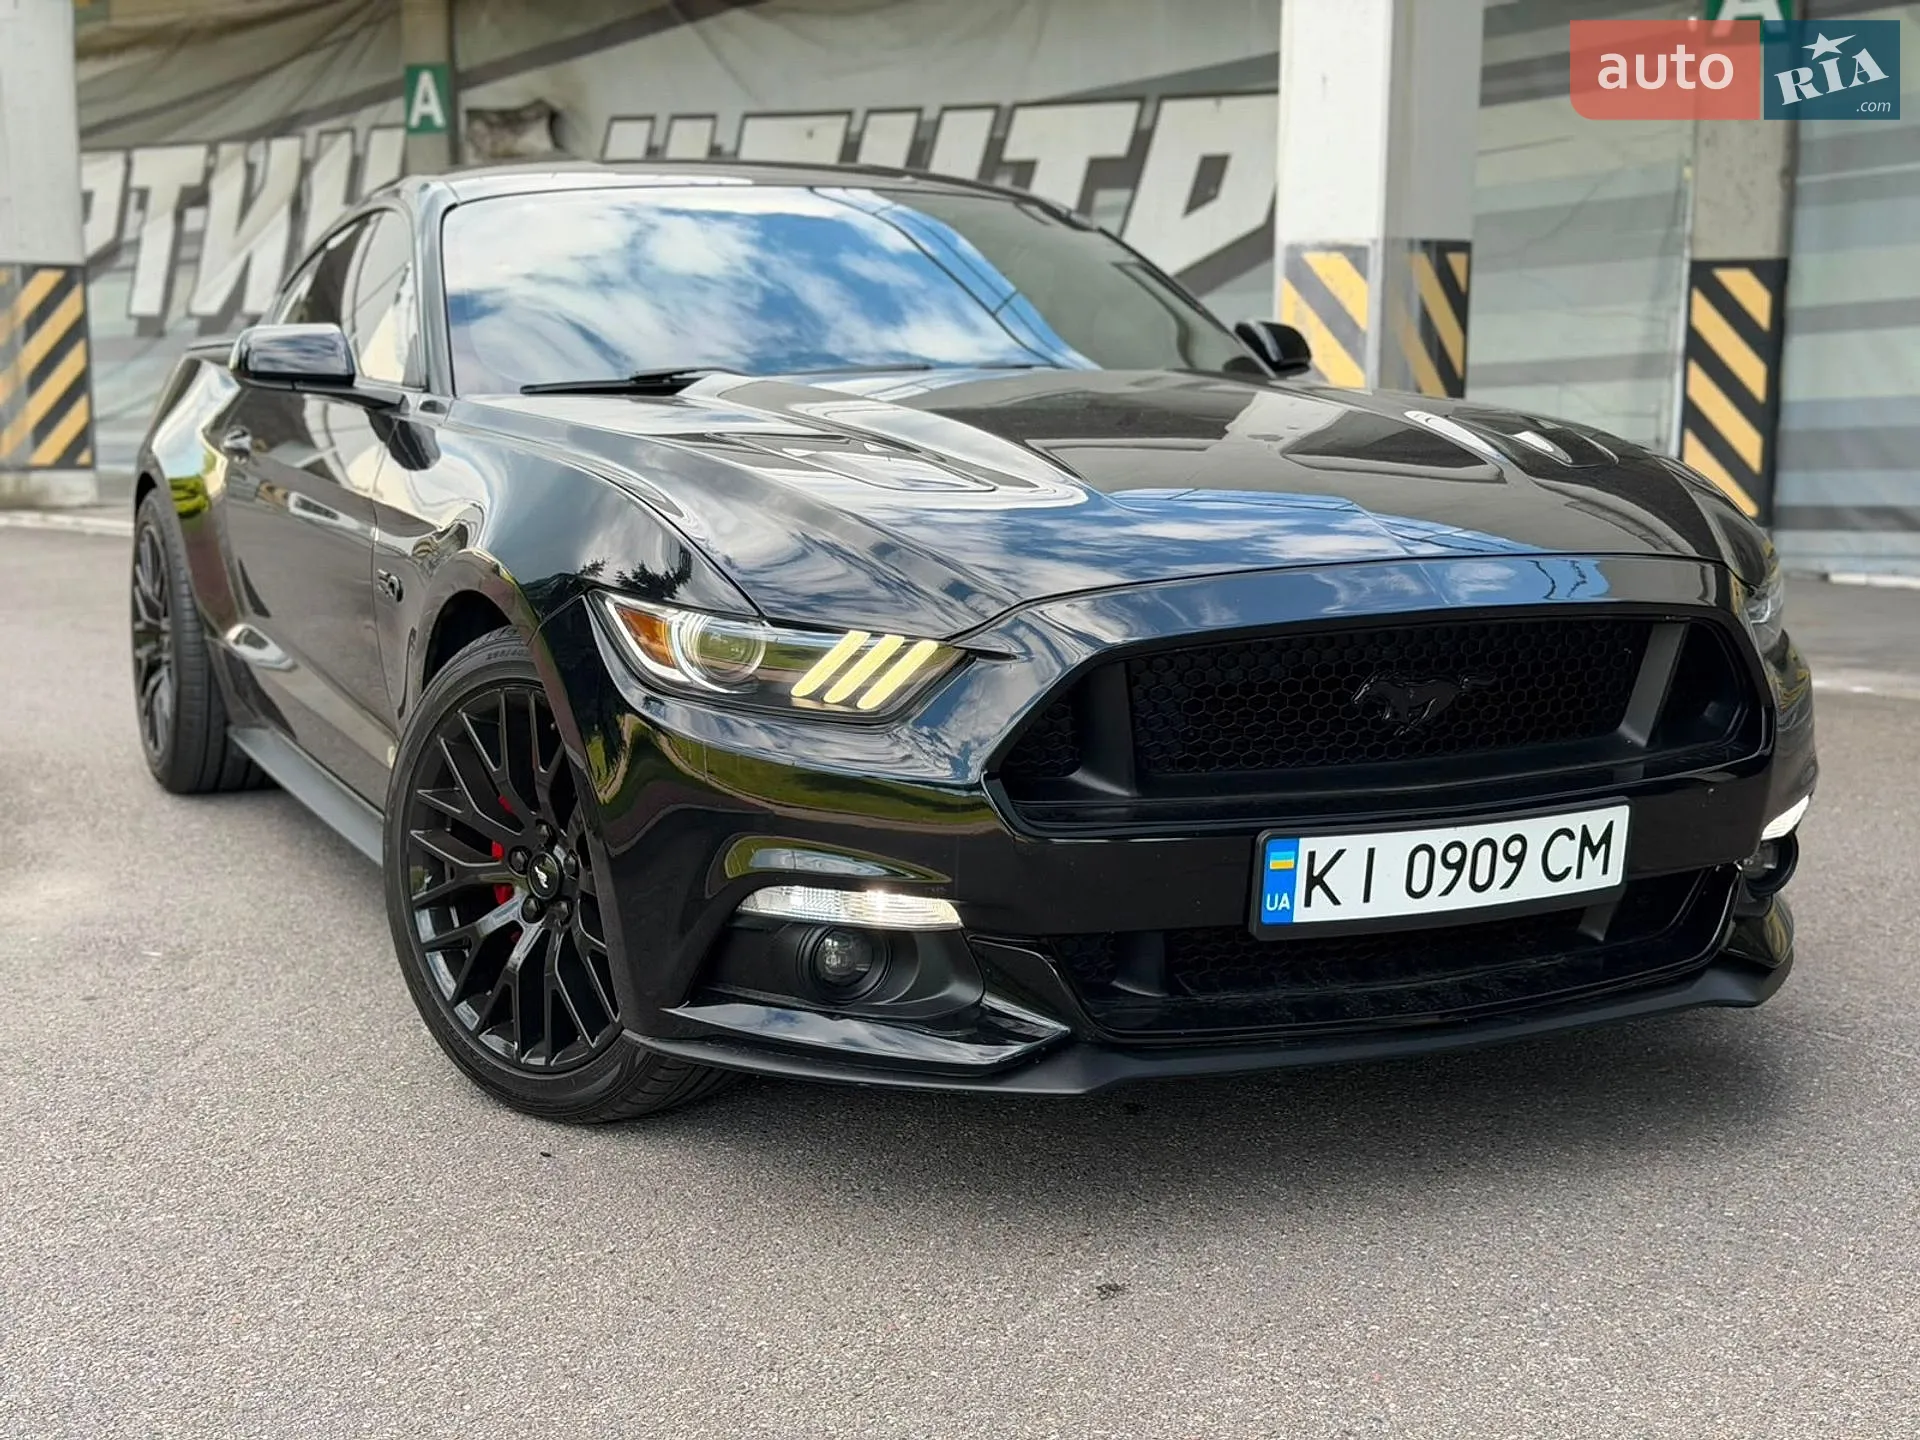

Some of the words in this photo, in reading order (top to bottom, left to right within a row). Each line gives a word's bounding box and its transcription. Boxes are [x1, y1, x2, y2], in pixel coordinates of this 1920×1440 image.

[409, 71, 445, 128] A
[1303, 847, 1376, 908] KI
[1404, 833, 1528, 900] 0909
[1541, 820, 1615, 883] CM
[1265, 892, 1291, 912] UA
